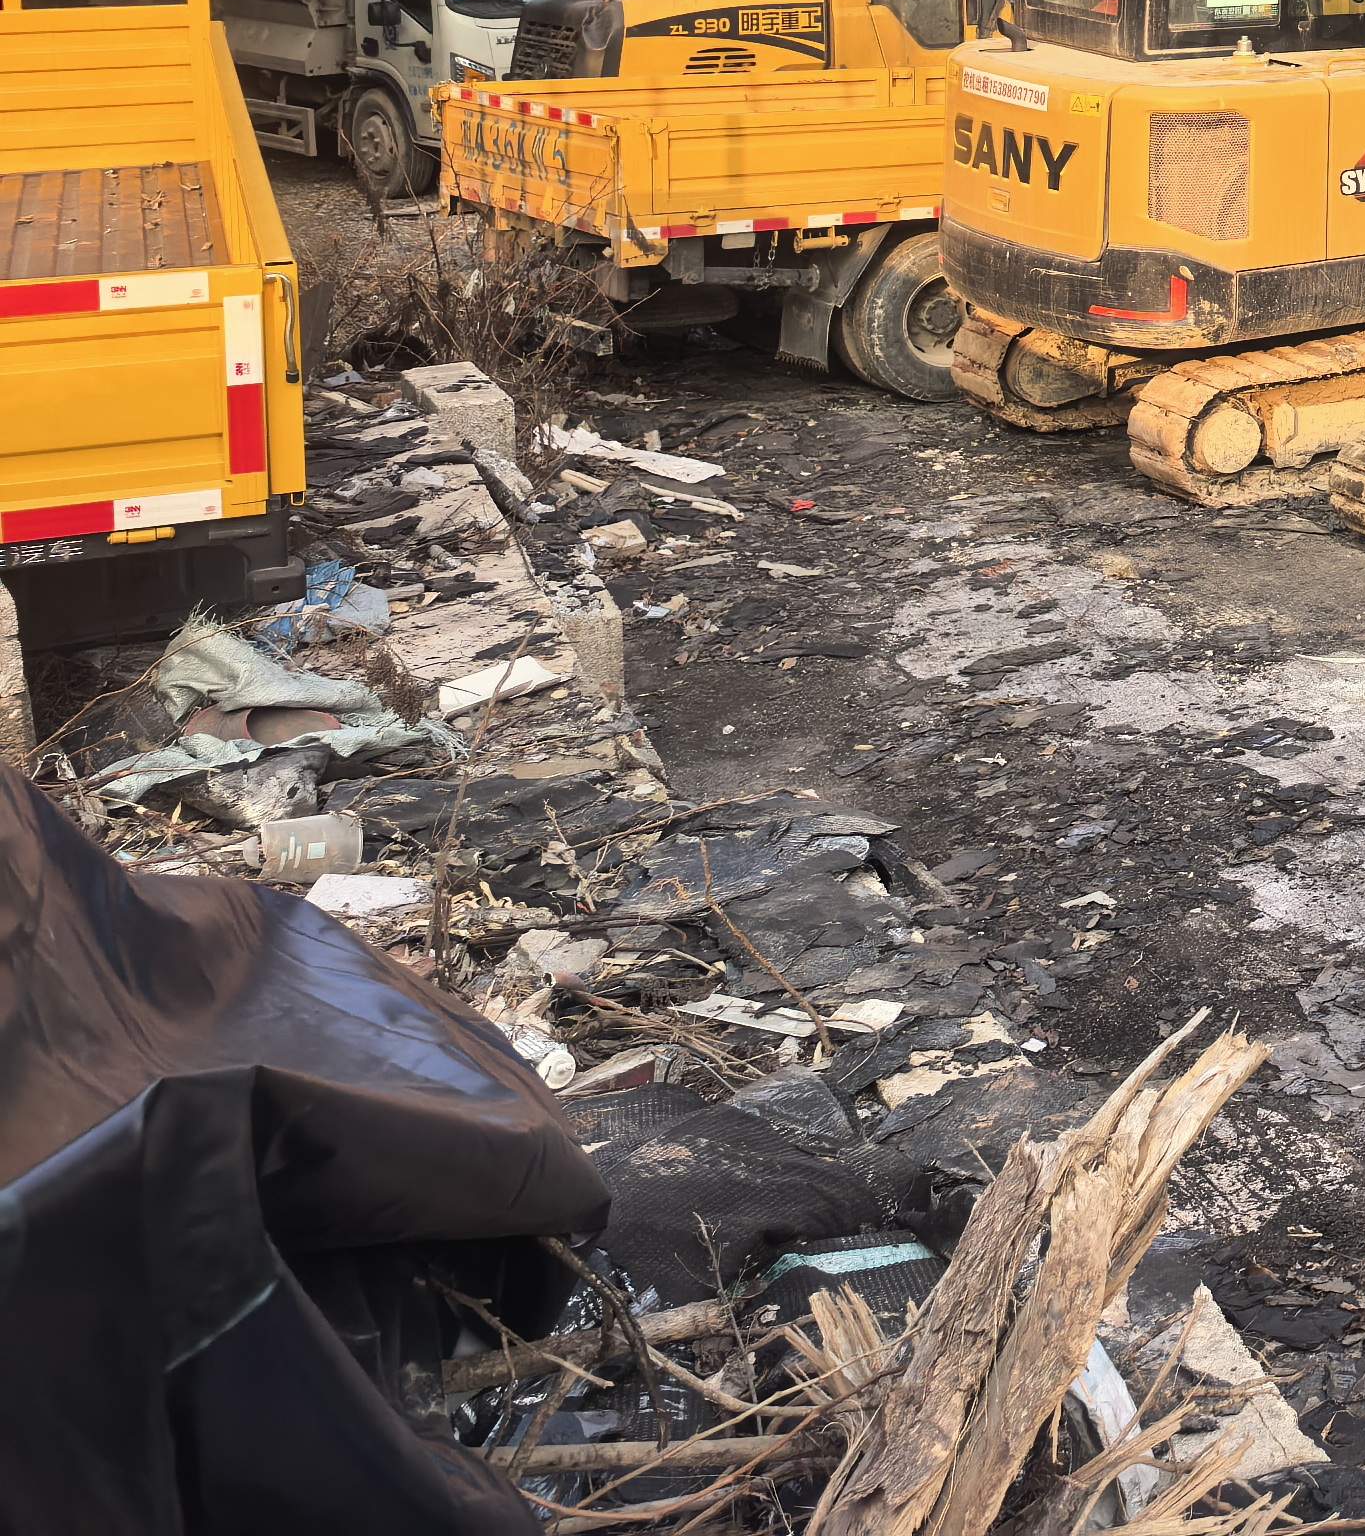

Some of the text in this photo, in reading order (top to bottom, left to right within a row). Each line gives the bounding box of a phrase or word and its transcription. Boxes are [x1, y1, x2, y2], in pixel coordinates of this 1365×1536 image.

[669, 17, 731, 35] ZL 930
[953, 112, 1080, 192] SANY
